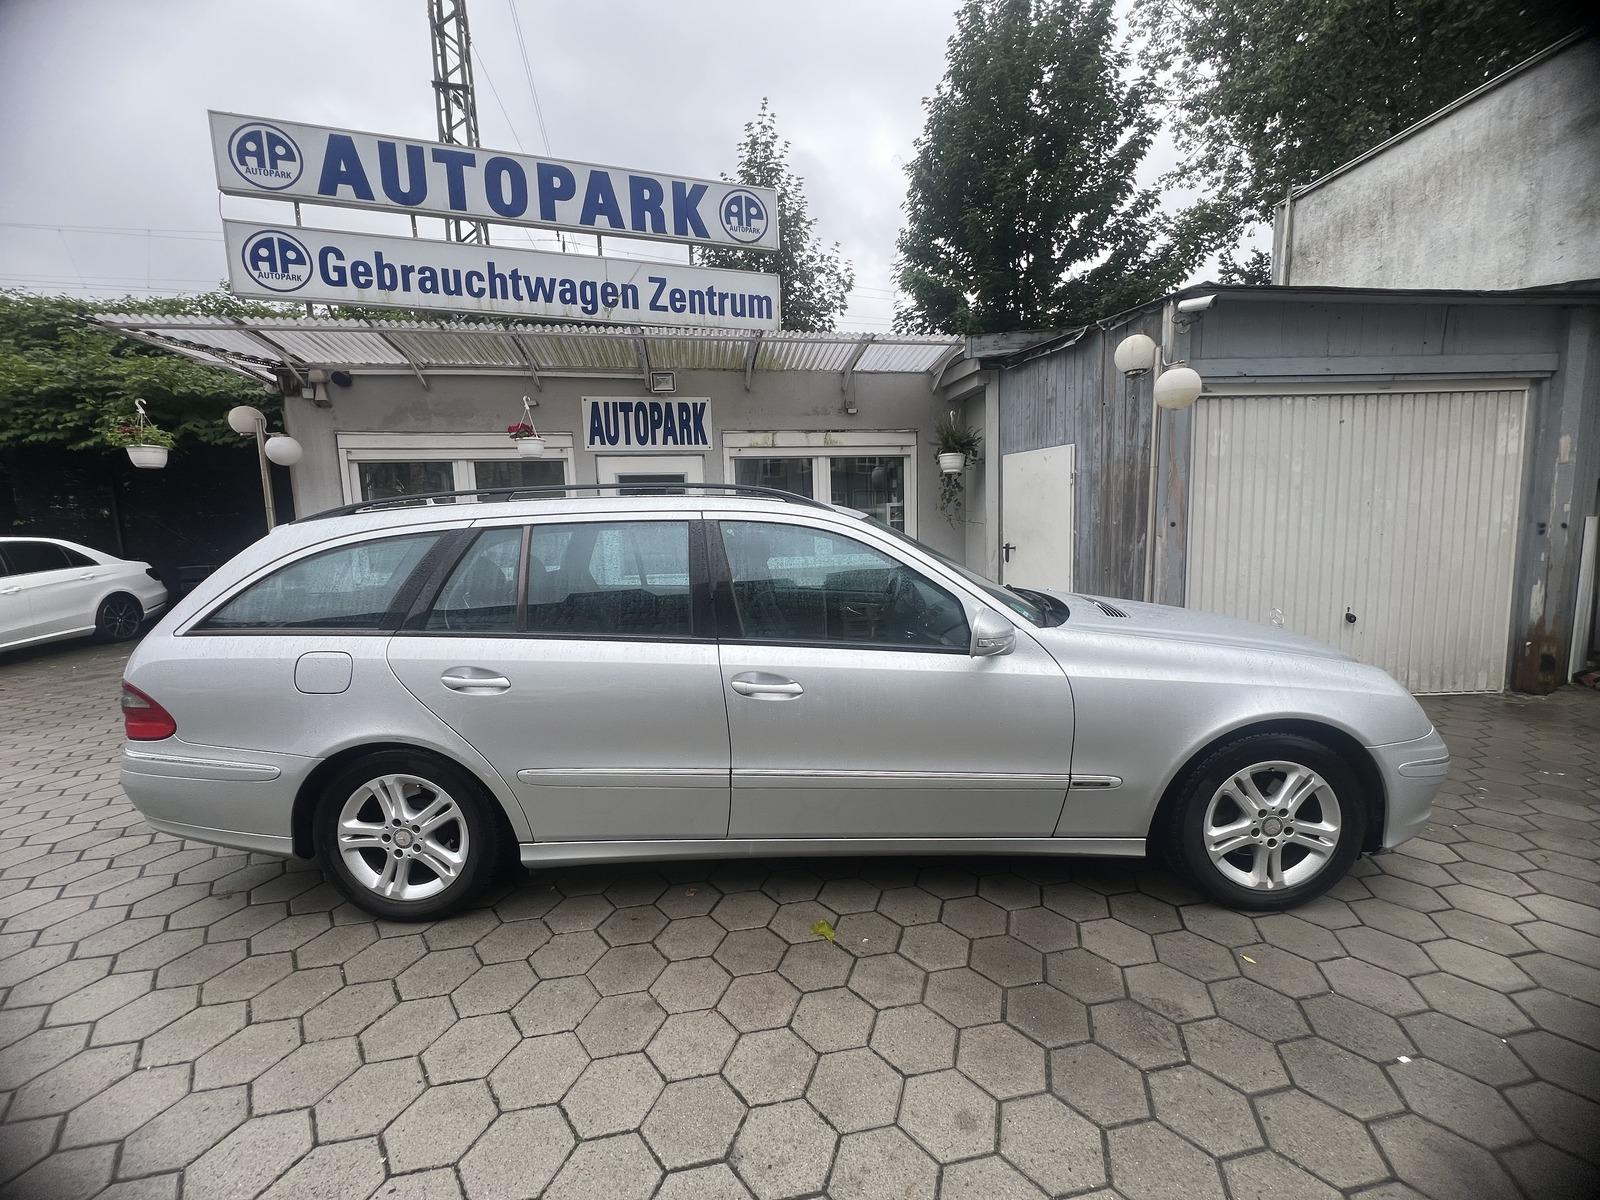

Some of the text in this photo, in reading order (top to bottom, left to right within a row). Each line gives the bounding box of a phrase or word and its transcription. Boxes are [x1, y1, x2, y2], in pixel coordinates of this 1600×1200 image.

[245, 166, 292, 180] AUTOPARK
[318, 133, 711, 239] AUTOPARK
[729, 225, 761, 234] AUTOPARK
[257, 271, 303, 282] AUTOPARK
[318, 245, 773, 320] Gebrauchtwagen Zentrum
[588, 400, 708, 446] AUTOPARK
